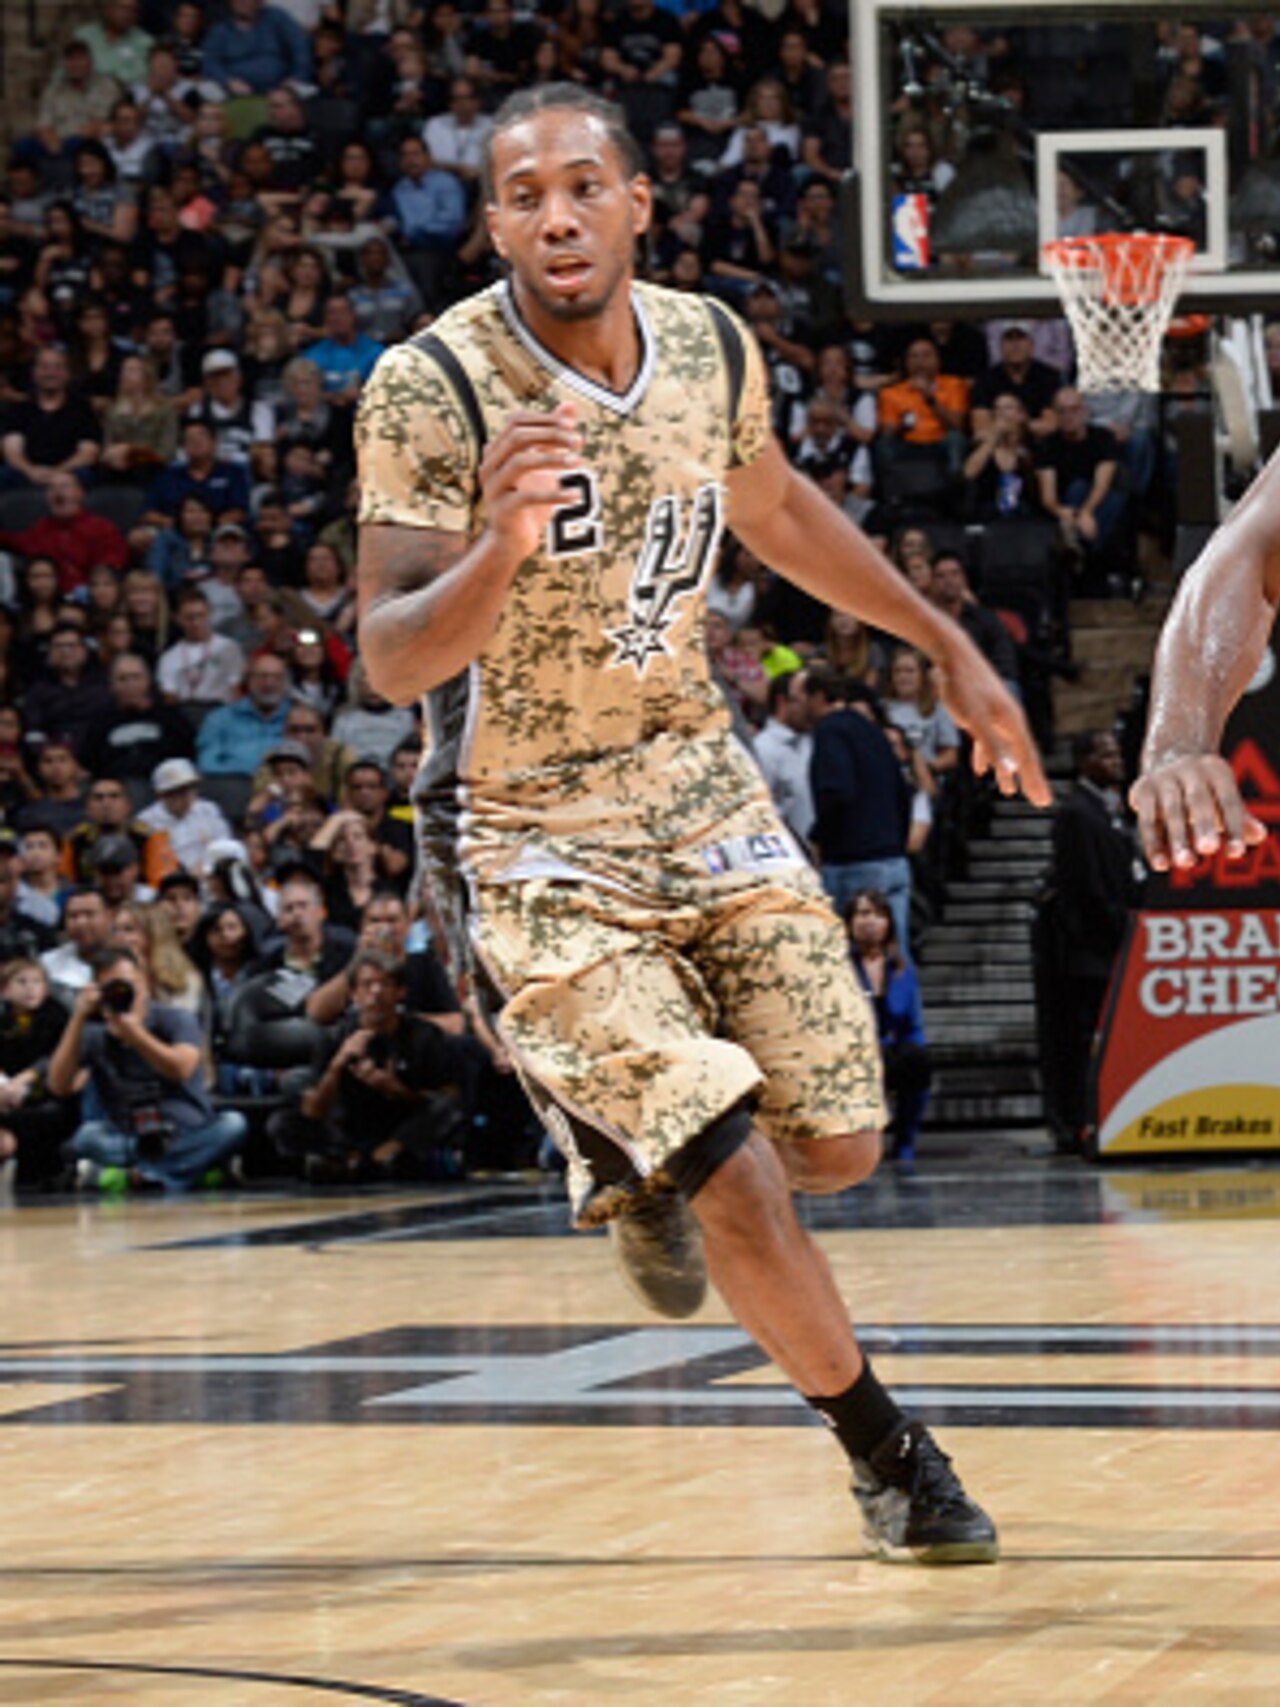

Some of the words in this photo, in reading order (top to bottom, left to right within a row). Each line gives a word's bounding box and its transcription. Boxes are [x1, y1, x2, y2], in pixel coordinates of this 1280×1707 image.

[549, 470, 602, 556] 2
[1138, 1115, 1188, 1138] Fast
[1195, 1114, 1273, 1136] Brakes
